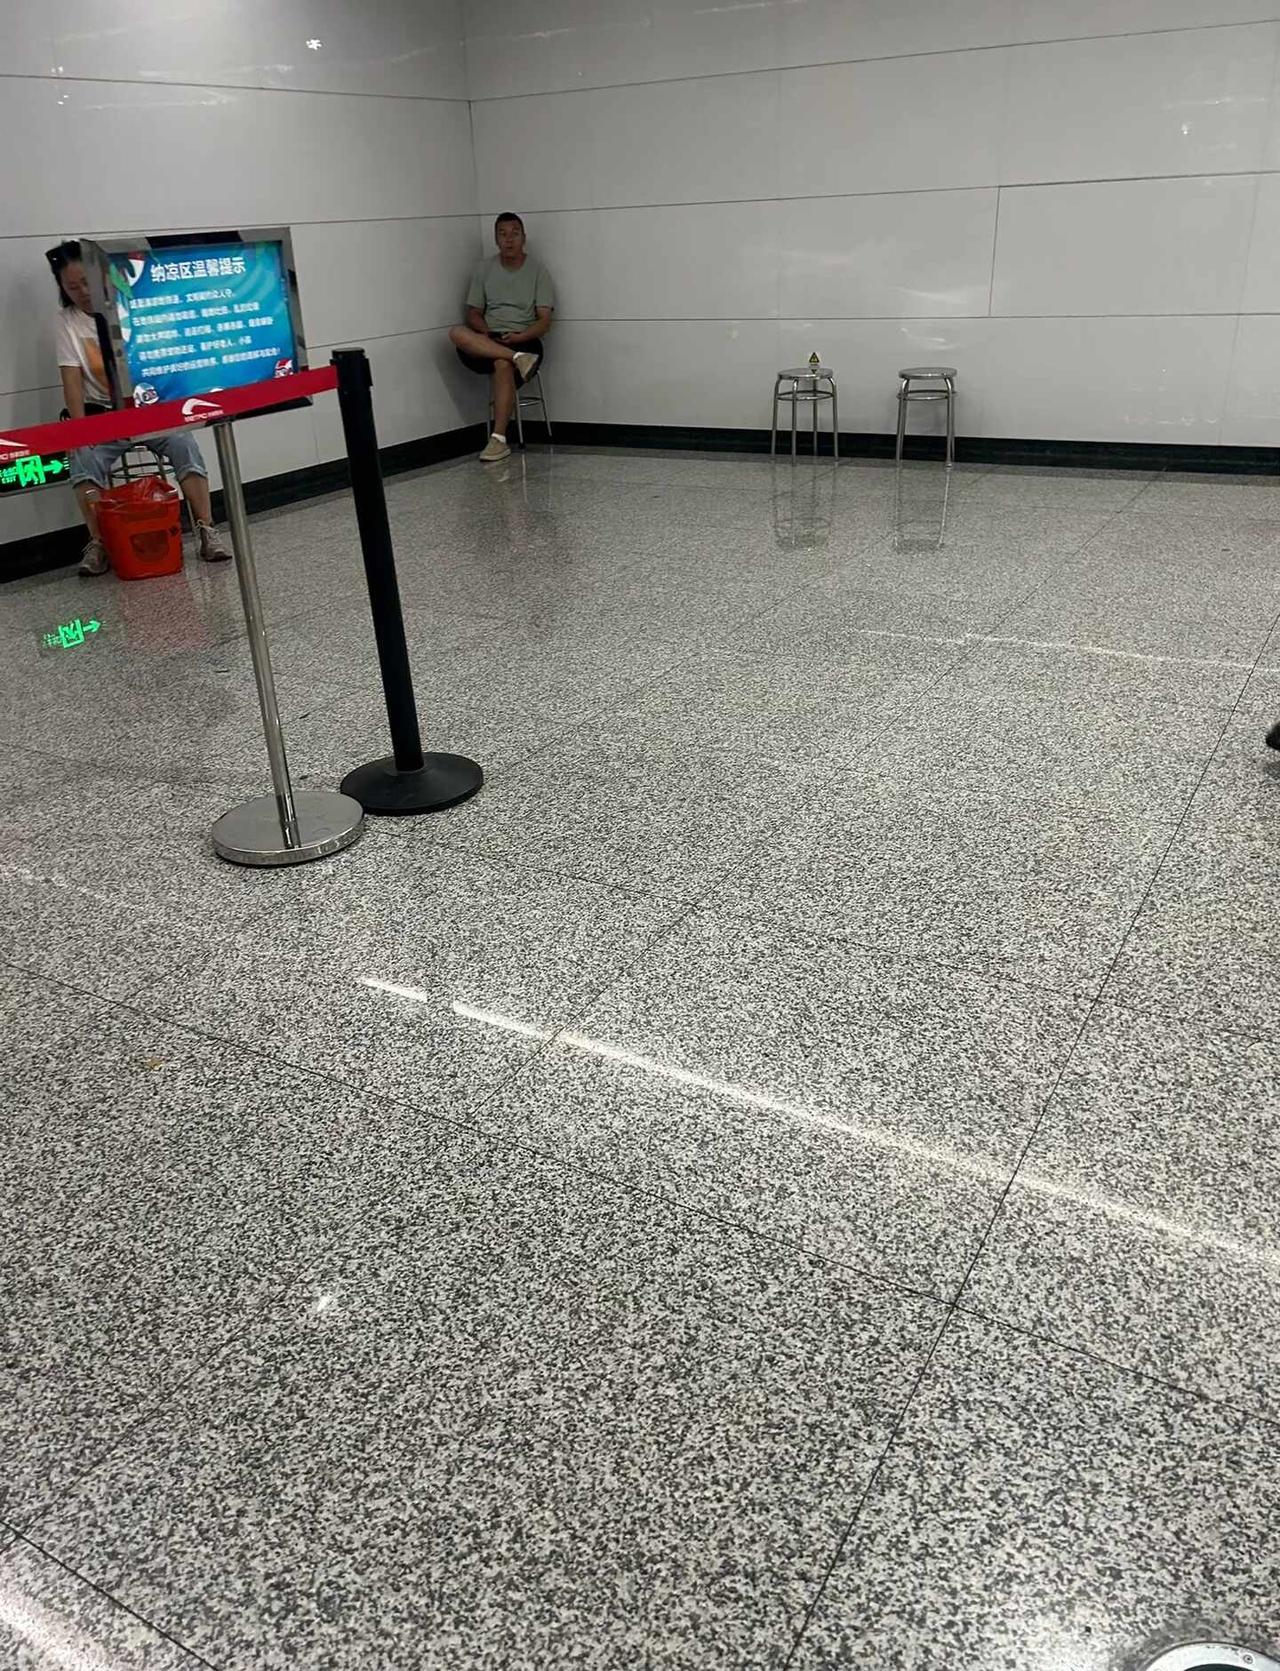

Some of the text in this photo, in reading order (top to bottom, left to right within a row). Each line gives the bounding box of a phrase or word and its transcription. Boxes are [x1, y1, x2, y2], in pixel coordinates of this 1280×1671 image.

[151, 256, 246, 283] 纳凉区温馨提示
